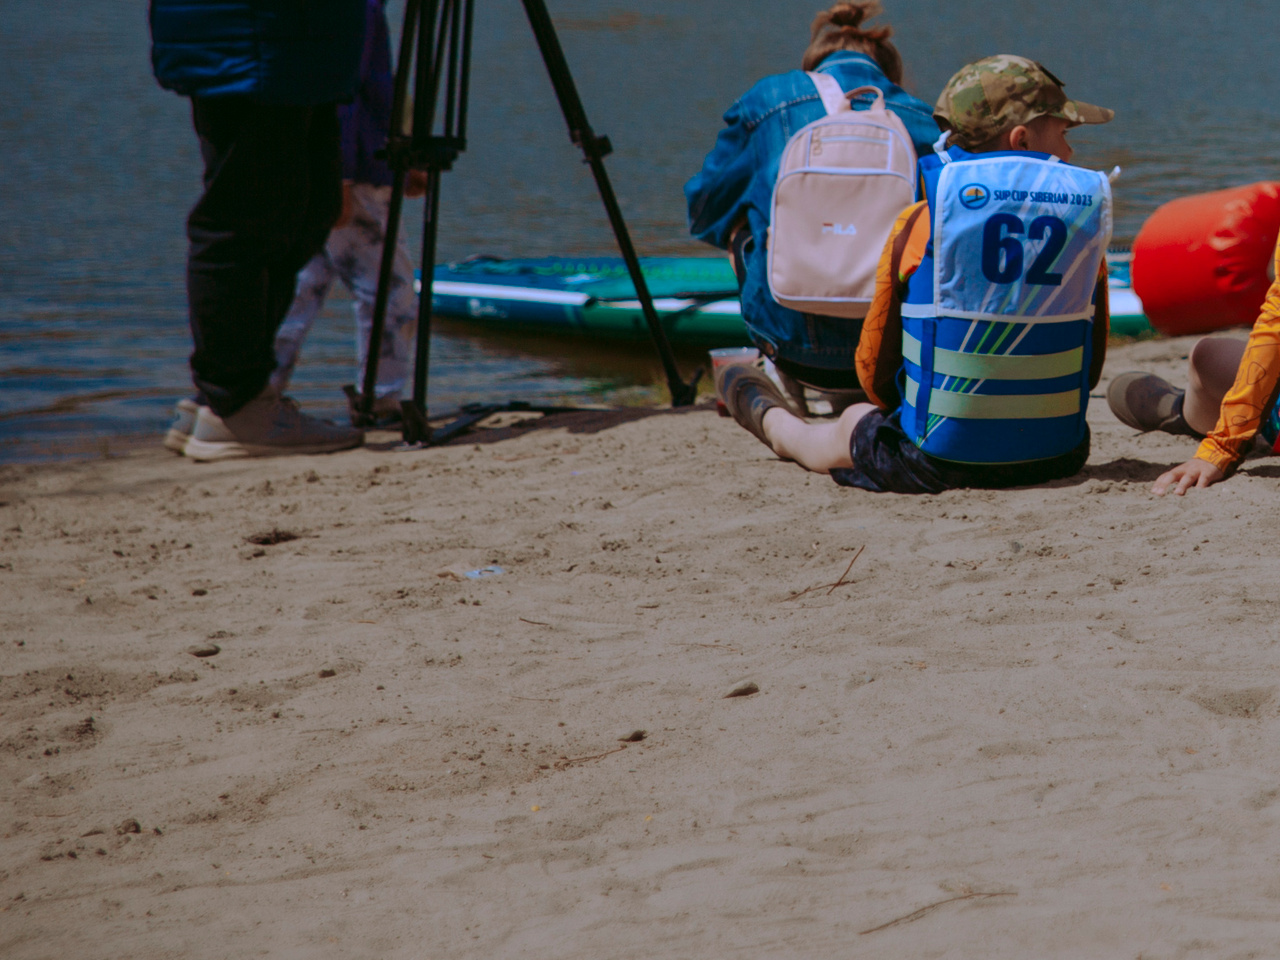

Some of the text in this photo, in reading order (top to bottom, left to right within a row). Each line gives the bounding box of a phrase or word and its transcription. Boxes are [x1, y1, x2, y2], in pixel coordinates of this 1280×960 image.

[993, 190, 1093, 207] SUP CUP SIBERIAN 2023
[822, 222, 857, 235] FILA
[981, 213, 1068, 286] 62
